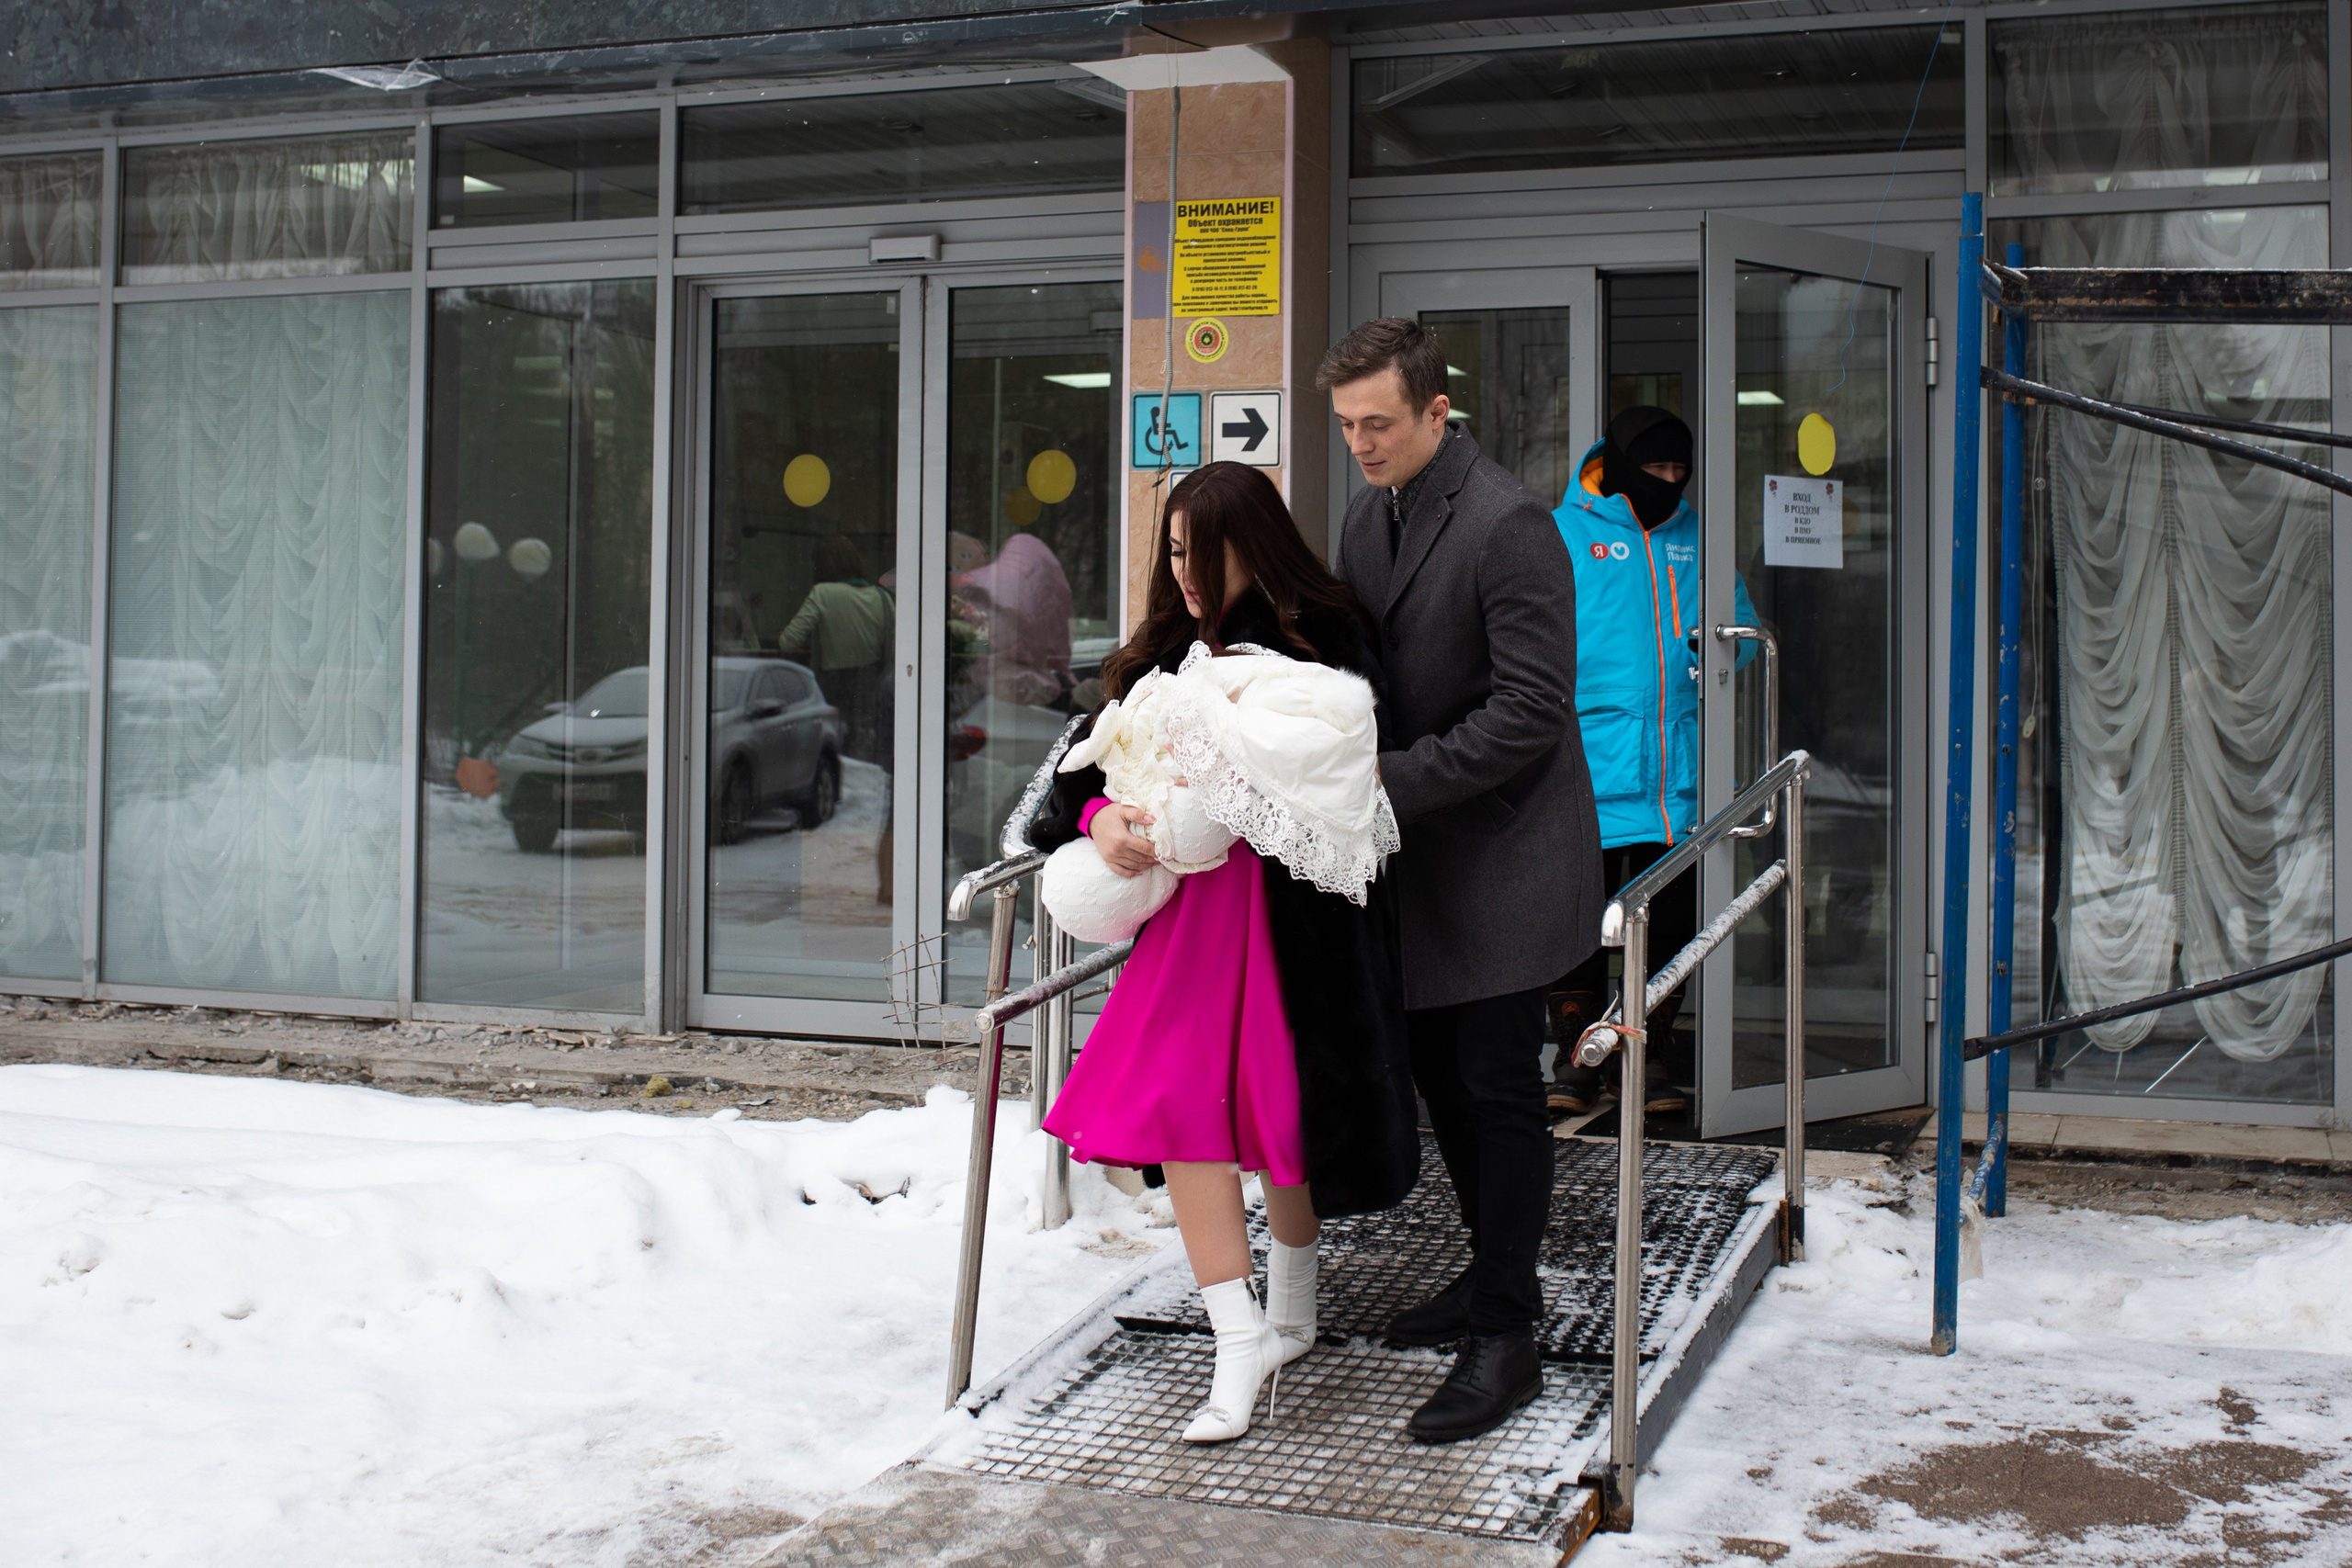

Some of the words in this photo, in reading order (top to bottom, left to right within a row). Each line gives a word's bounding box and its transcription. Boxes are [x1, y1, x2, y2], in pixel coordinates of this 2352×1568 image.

[1178, 201, 1274, 217] ВНИМАНИЕ!
[1188, 219, 1216, 227] Объект
[1218, 218, 1263, 226] охраняется
[1792, 492, 1811, 502] ВХОД
[1784, 505, 1789, 513] В
[1791, 505, 1820, 515] РОДДОМ
[1594, 546, 1604, 558] Я
